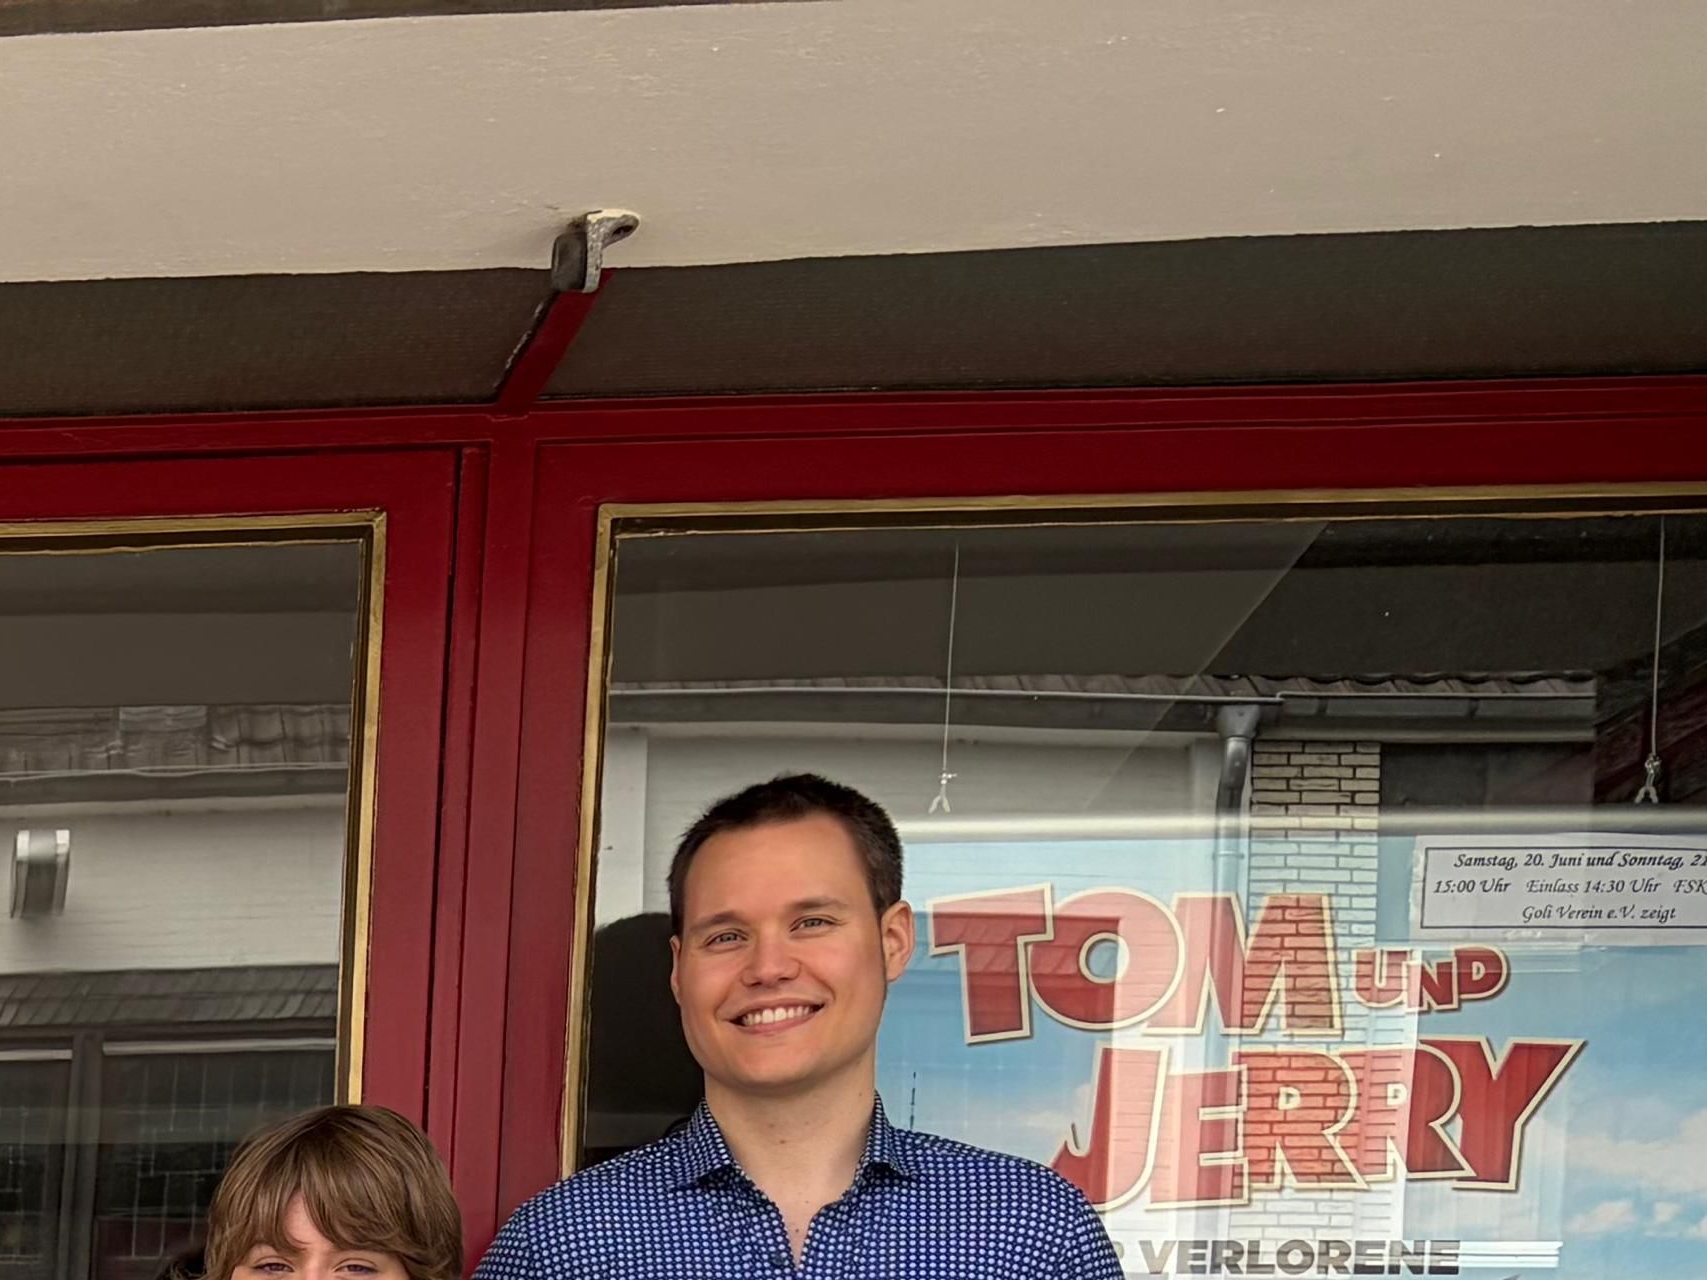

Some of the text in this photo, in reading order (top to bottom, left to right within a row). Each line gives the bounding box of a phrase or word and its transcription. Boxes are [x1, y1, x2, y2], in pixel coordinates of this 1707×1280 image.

[1454, 852, 1518, 871] Samstag,
[1524, 853, 1544, 867] 20.
[1549, 852, 1583, 869] Juni
[1587, 851, 1617, 868] und
[1617, 852, 1685, 871] Sonntag,
[1433, 879, 1476, 894] 15:00
[1479, 878, 1511, 894] Uhr
[1526, 878, 1580, 894] Einlass
[1584, 879, 1625, 894] 14:30
[1629, 879, 1662, 894] Uhr
[1556, 905, 1603, 920] Verein
[1607, 904, 1635, 920] e.V.
[1639, 905, 1676, 924] zeigt
[925, 882, 1511, 1046] TOM UND
[1047, 1035, 1588, 1213] JERRY
[1138, 1239, 1461, 1275] VERLORENE
